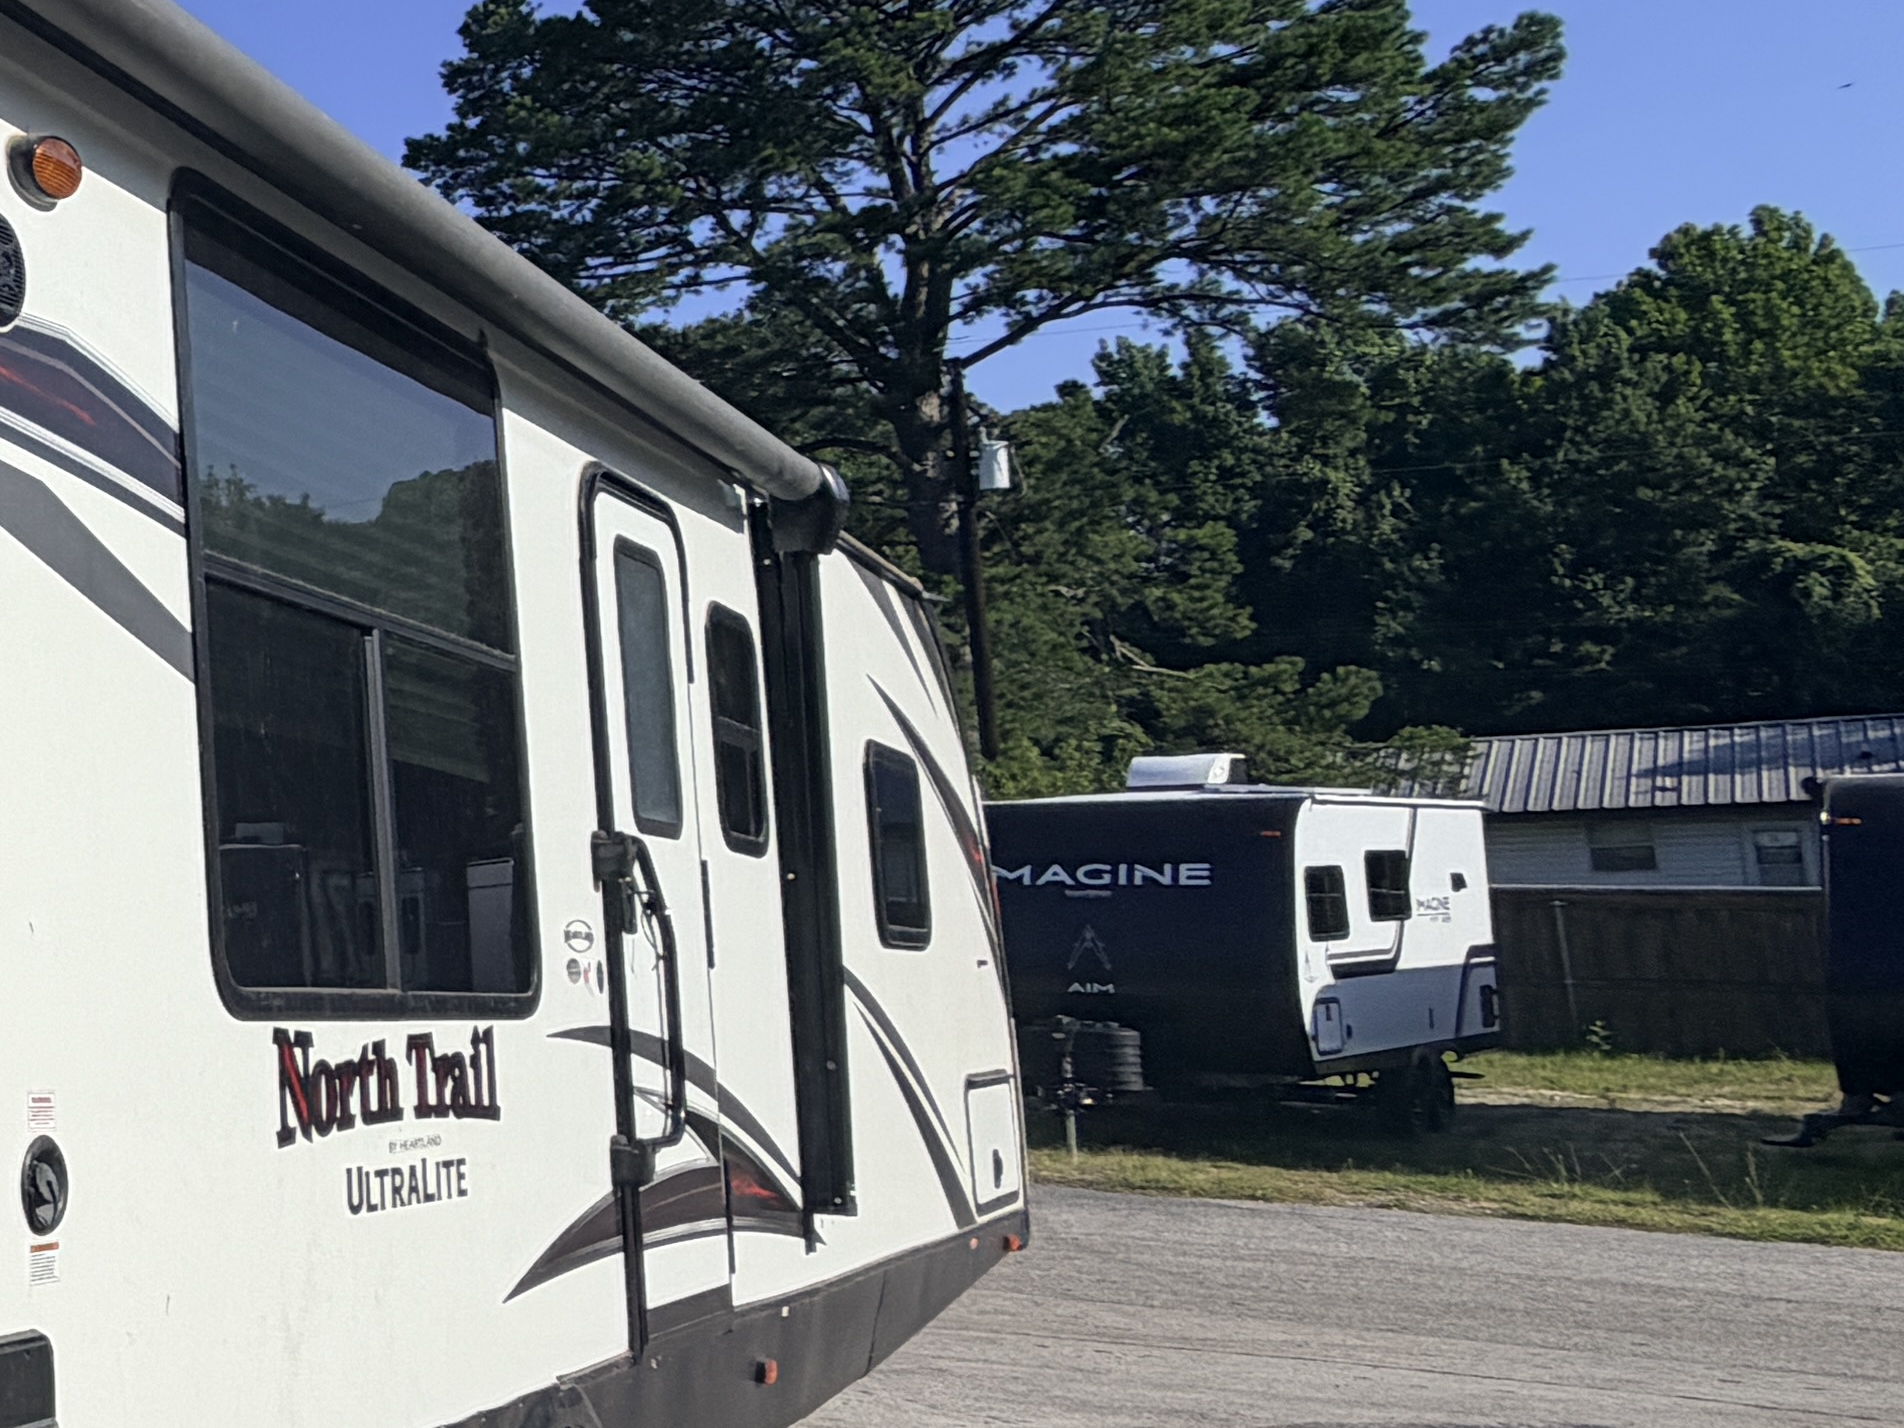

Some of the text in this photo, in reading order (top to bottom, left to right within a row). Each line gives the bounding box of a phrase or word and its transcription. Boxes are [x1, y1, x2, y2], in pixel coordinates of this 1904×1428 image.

[991, 863, 1212, 886] MAGINE
[1067, 982, 1115, 993] AIM
[273, 1025, 501, 1149] North Trail
